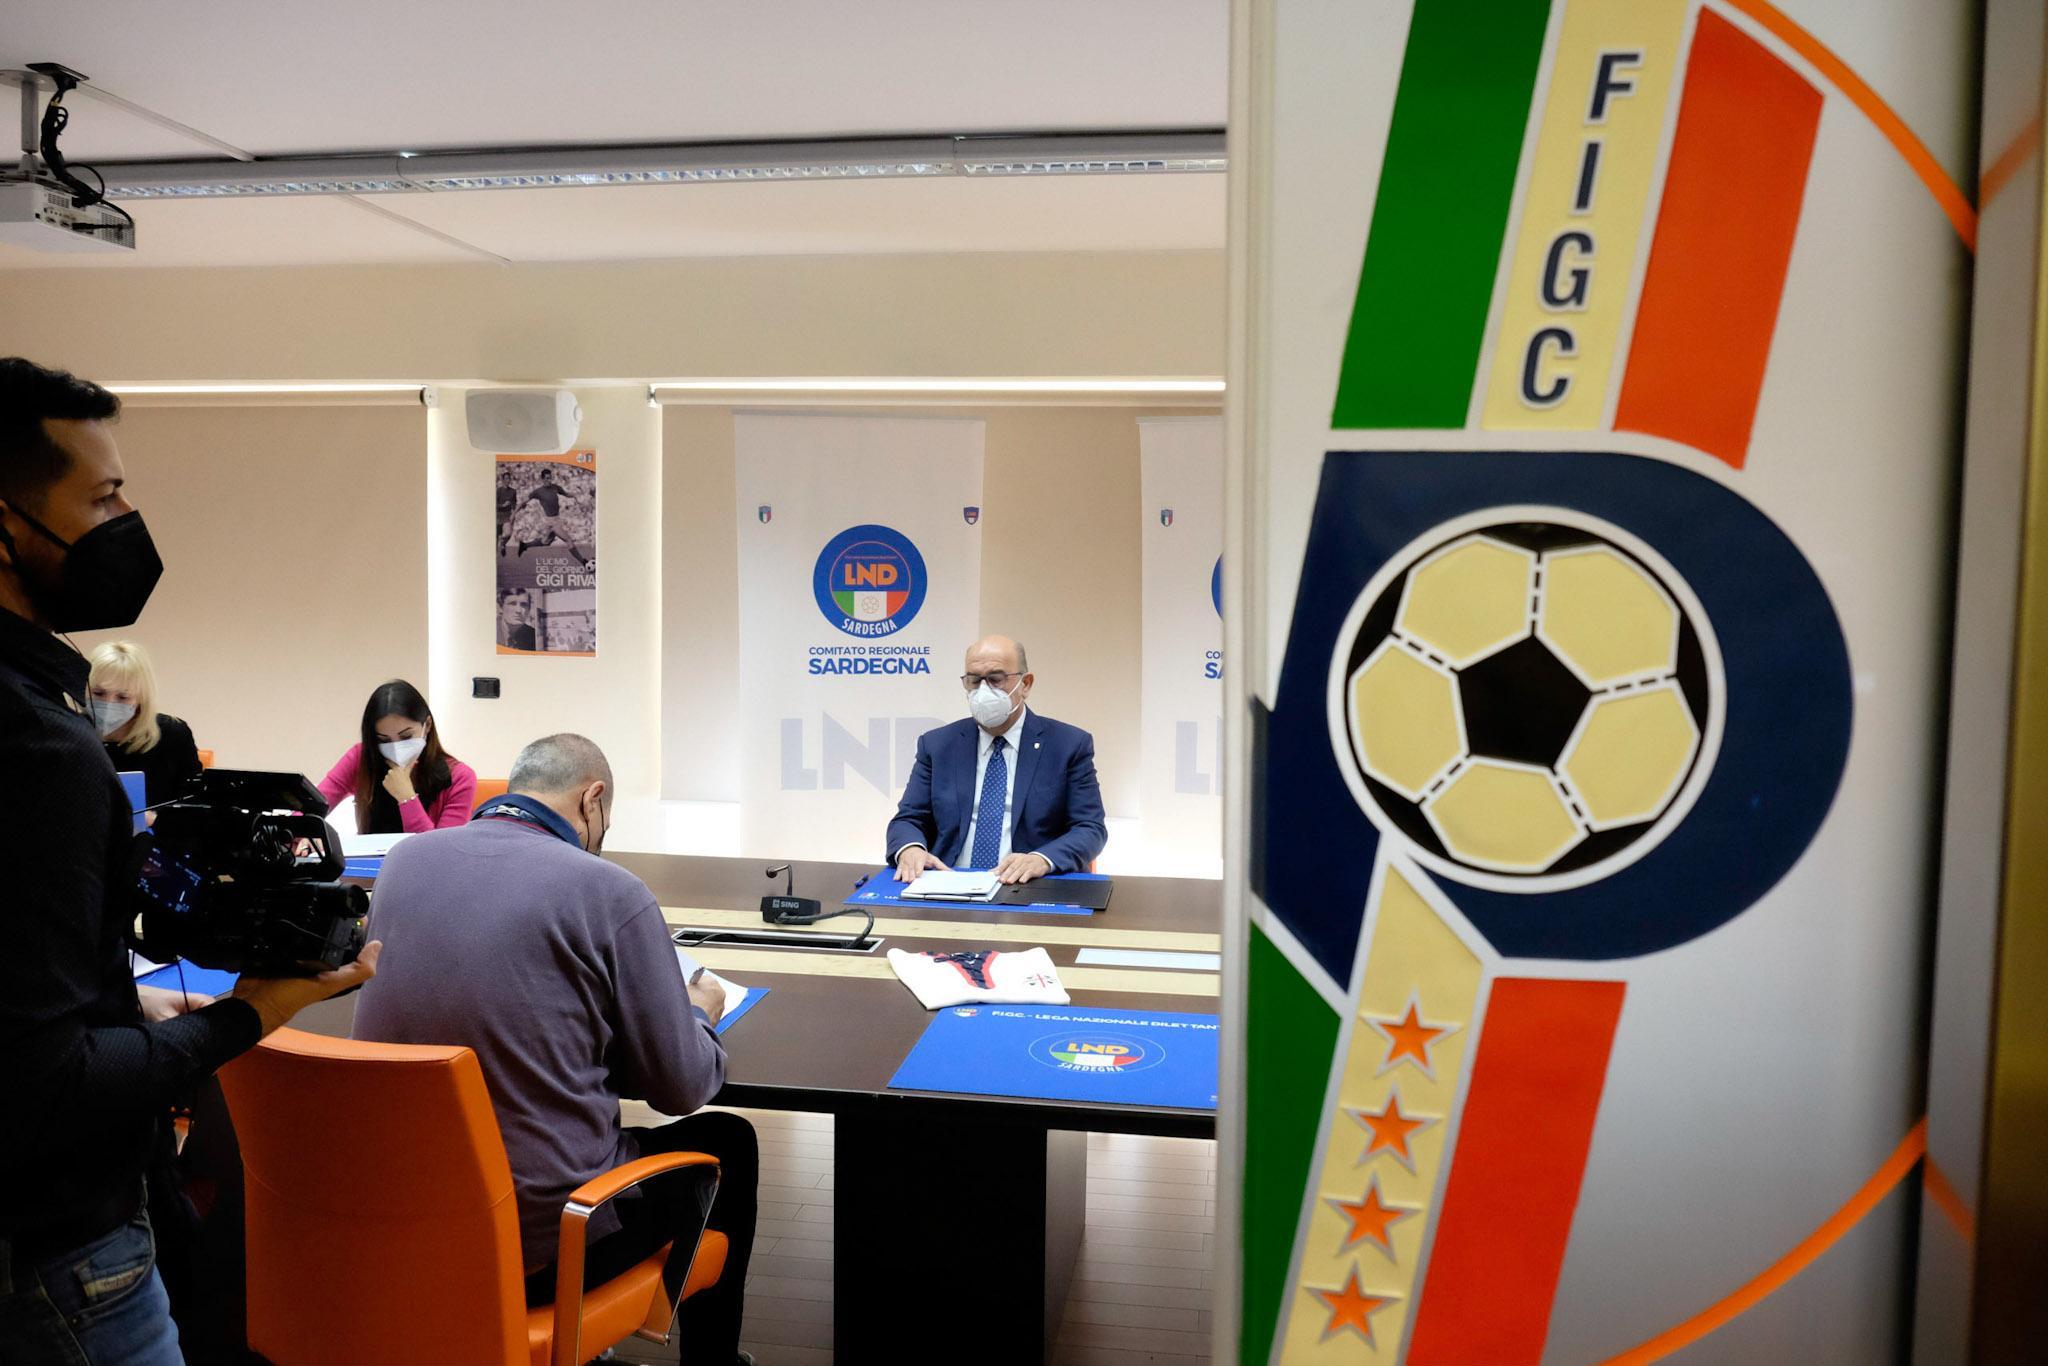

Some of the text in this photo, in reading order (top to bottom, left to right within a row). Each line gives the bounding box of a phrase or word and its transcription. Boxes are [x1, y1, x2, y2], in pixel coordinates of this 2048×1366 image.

[1522, 52, 1640, 404] FIGC
[535, 565, 585, 574] DEL GIORNO
[844, 562, 898, 588] LND
[536, 573, 596, 587] GIGI RIVA
[841, 618, 898, 636] SARDEGNA
[808, 646, 931, 656] COMITATO REGIONALE
[808, 657, 931, 675] SARDEGNA
[1034, 1013, 1071, 1022] LEGA
[1072, 1016, 1149, 1026] NAZIONALE
[1067, 1041, 1130, 1055] LND
[1057, 1061, 1126, 1073] SARDEGNA
